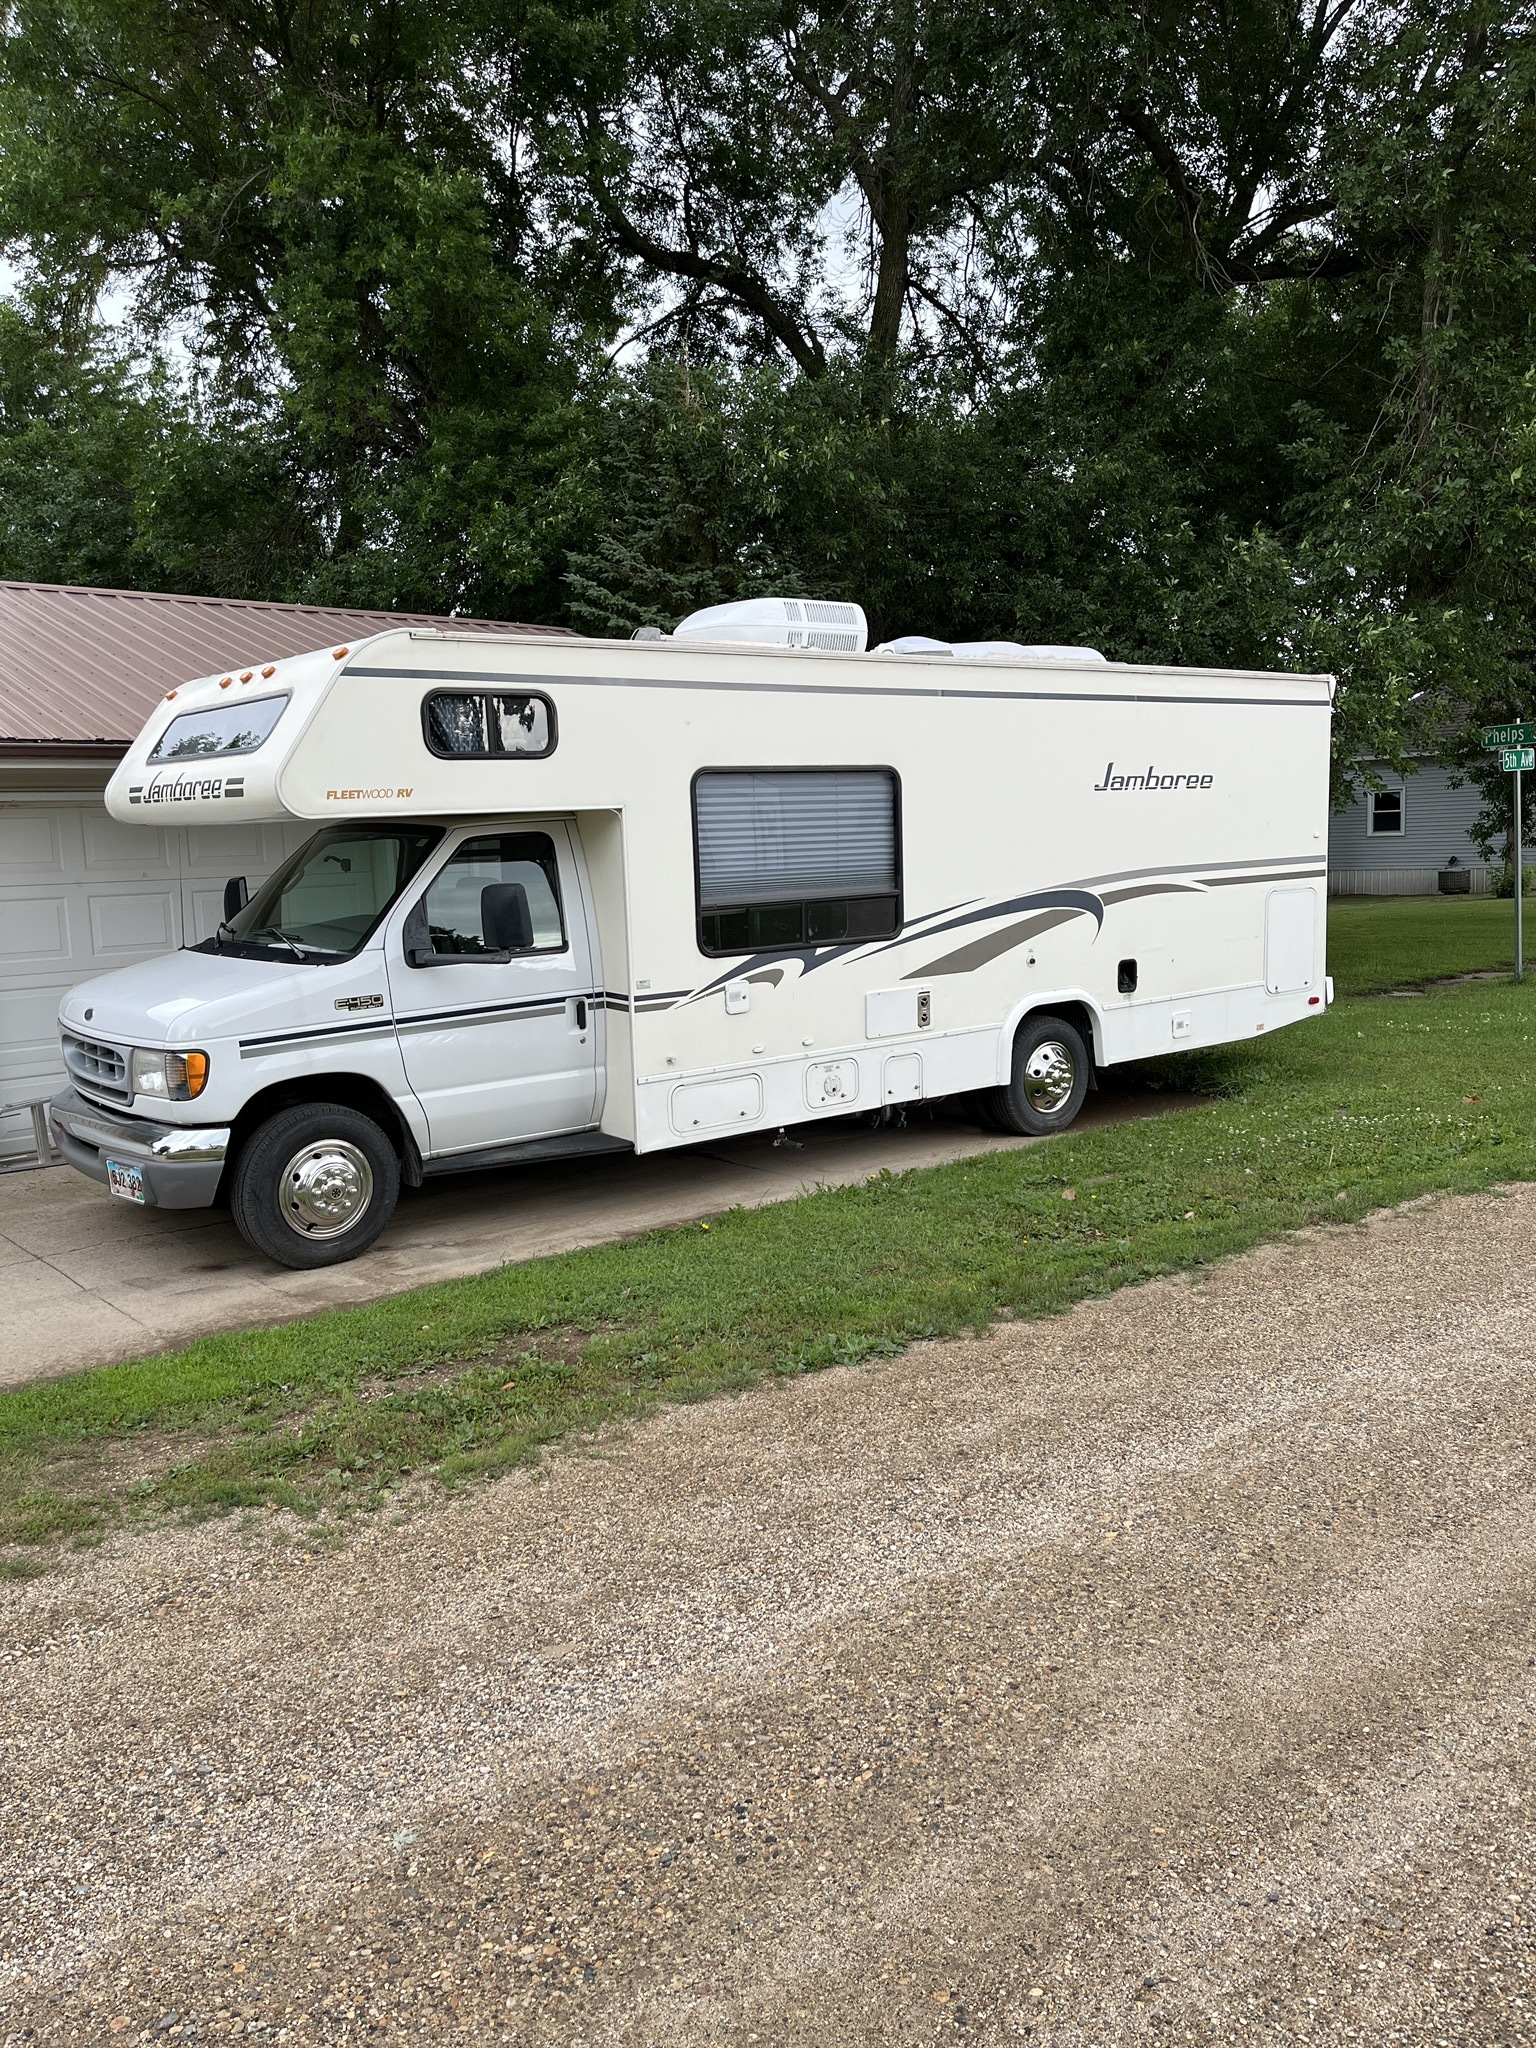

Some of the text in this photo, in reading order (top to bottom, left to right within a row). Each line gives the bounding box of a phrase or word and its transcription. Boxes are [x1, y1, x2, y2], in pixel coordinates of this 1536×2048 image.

[1505, 751, 1533, 769] 5th Ave
[1094, 762, 1213, 791] Jamboree
[143, 770, 222, 804] Jamboree
[326, 788, 414, 800] FLEETWOOD RV
[335, 995, 383, 1010] E-450
